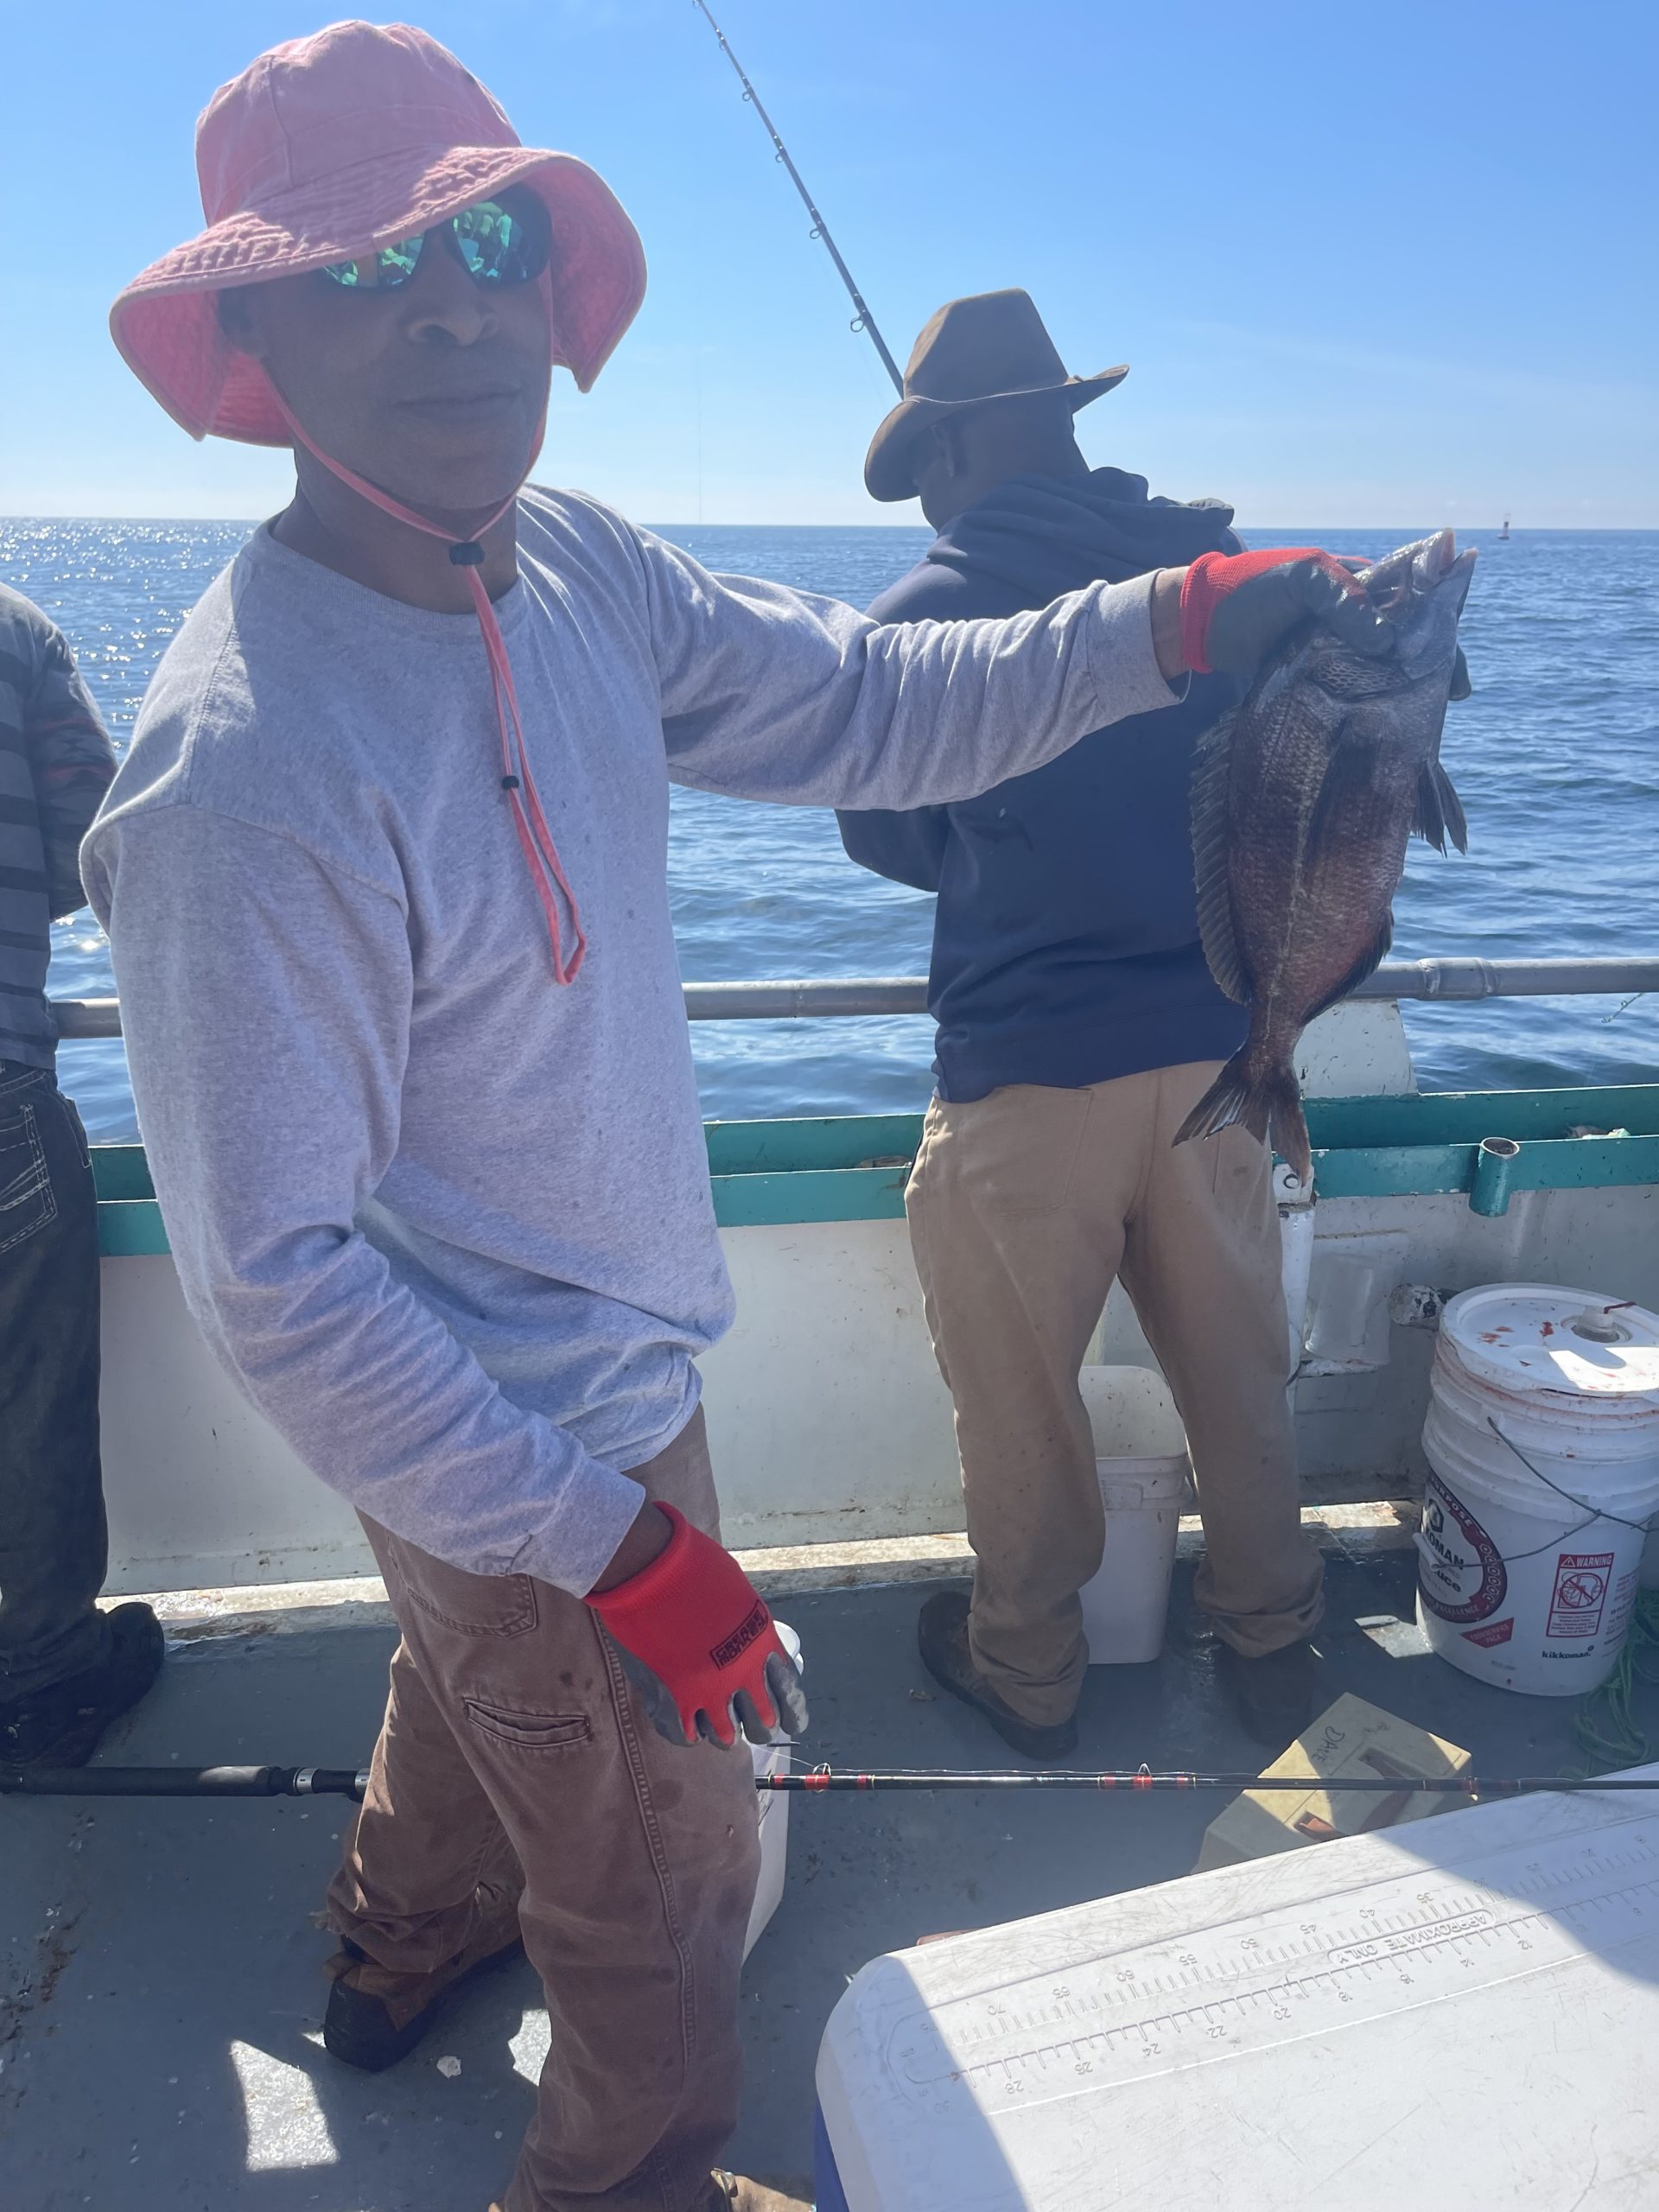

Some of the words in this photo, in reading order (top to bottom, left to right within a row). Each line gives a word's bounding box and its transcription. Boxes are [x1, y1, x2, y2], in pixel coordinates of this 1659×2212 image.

[1576, 1555, 1612, 1567] WARNING
[1311, 1726, 1345, 1763] DAVE
[1382, 1912, 1487, 1951] APPROXIMATE
[1336, 1944, 1378, 1964] ONLY
